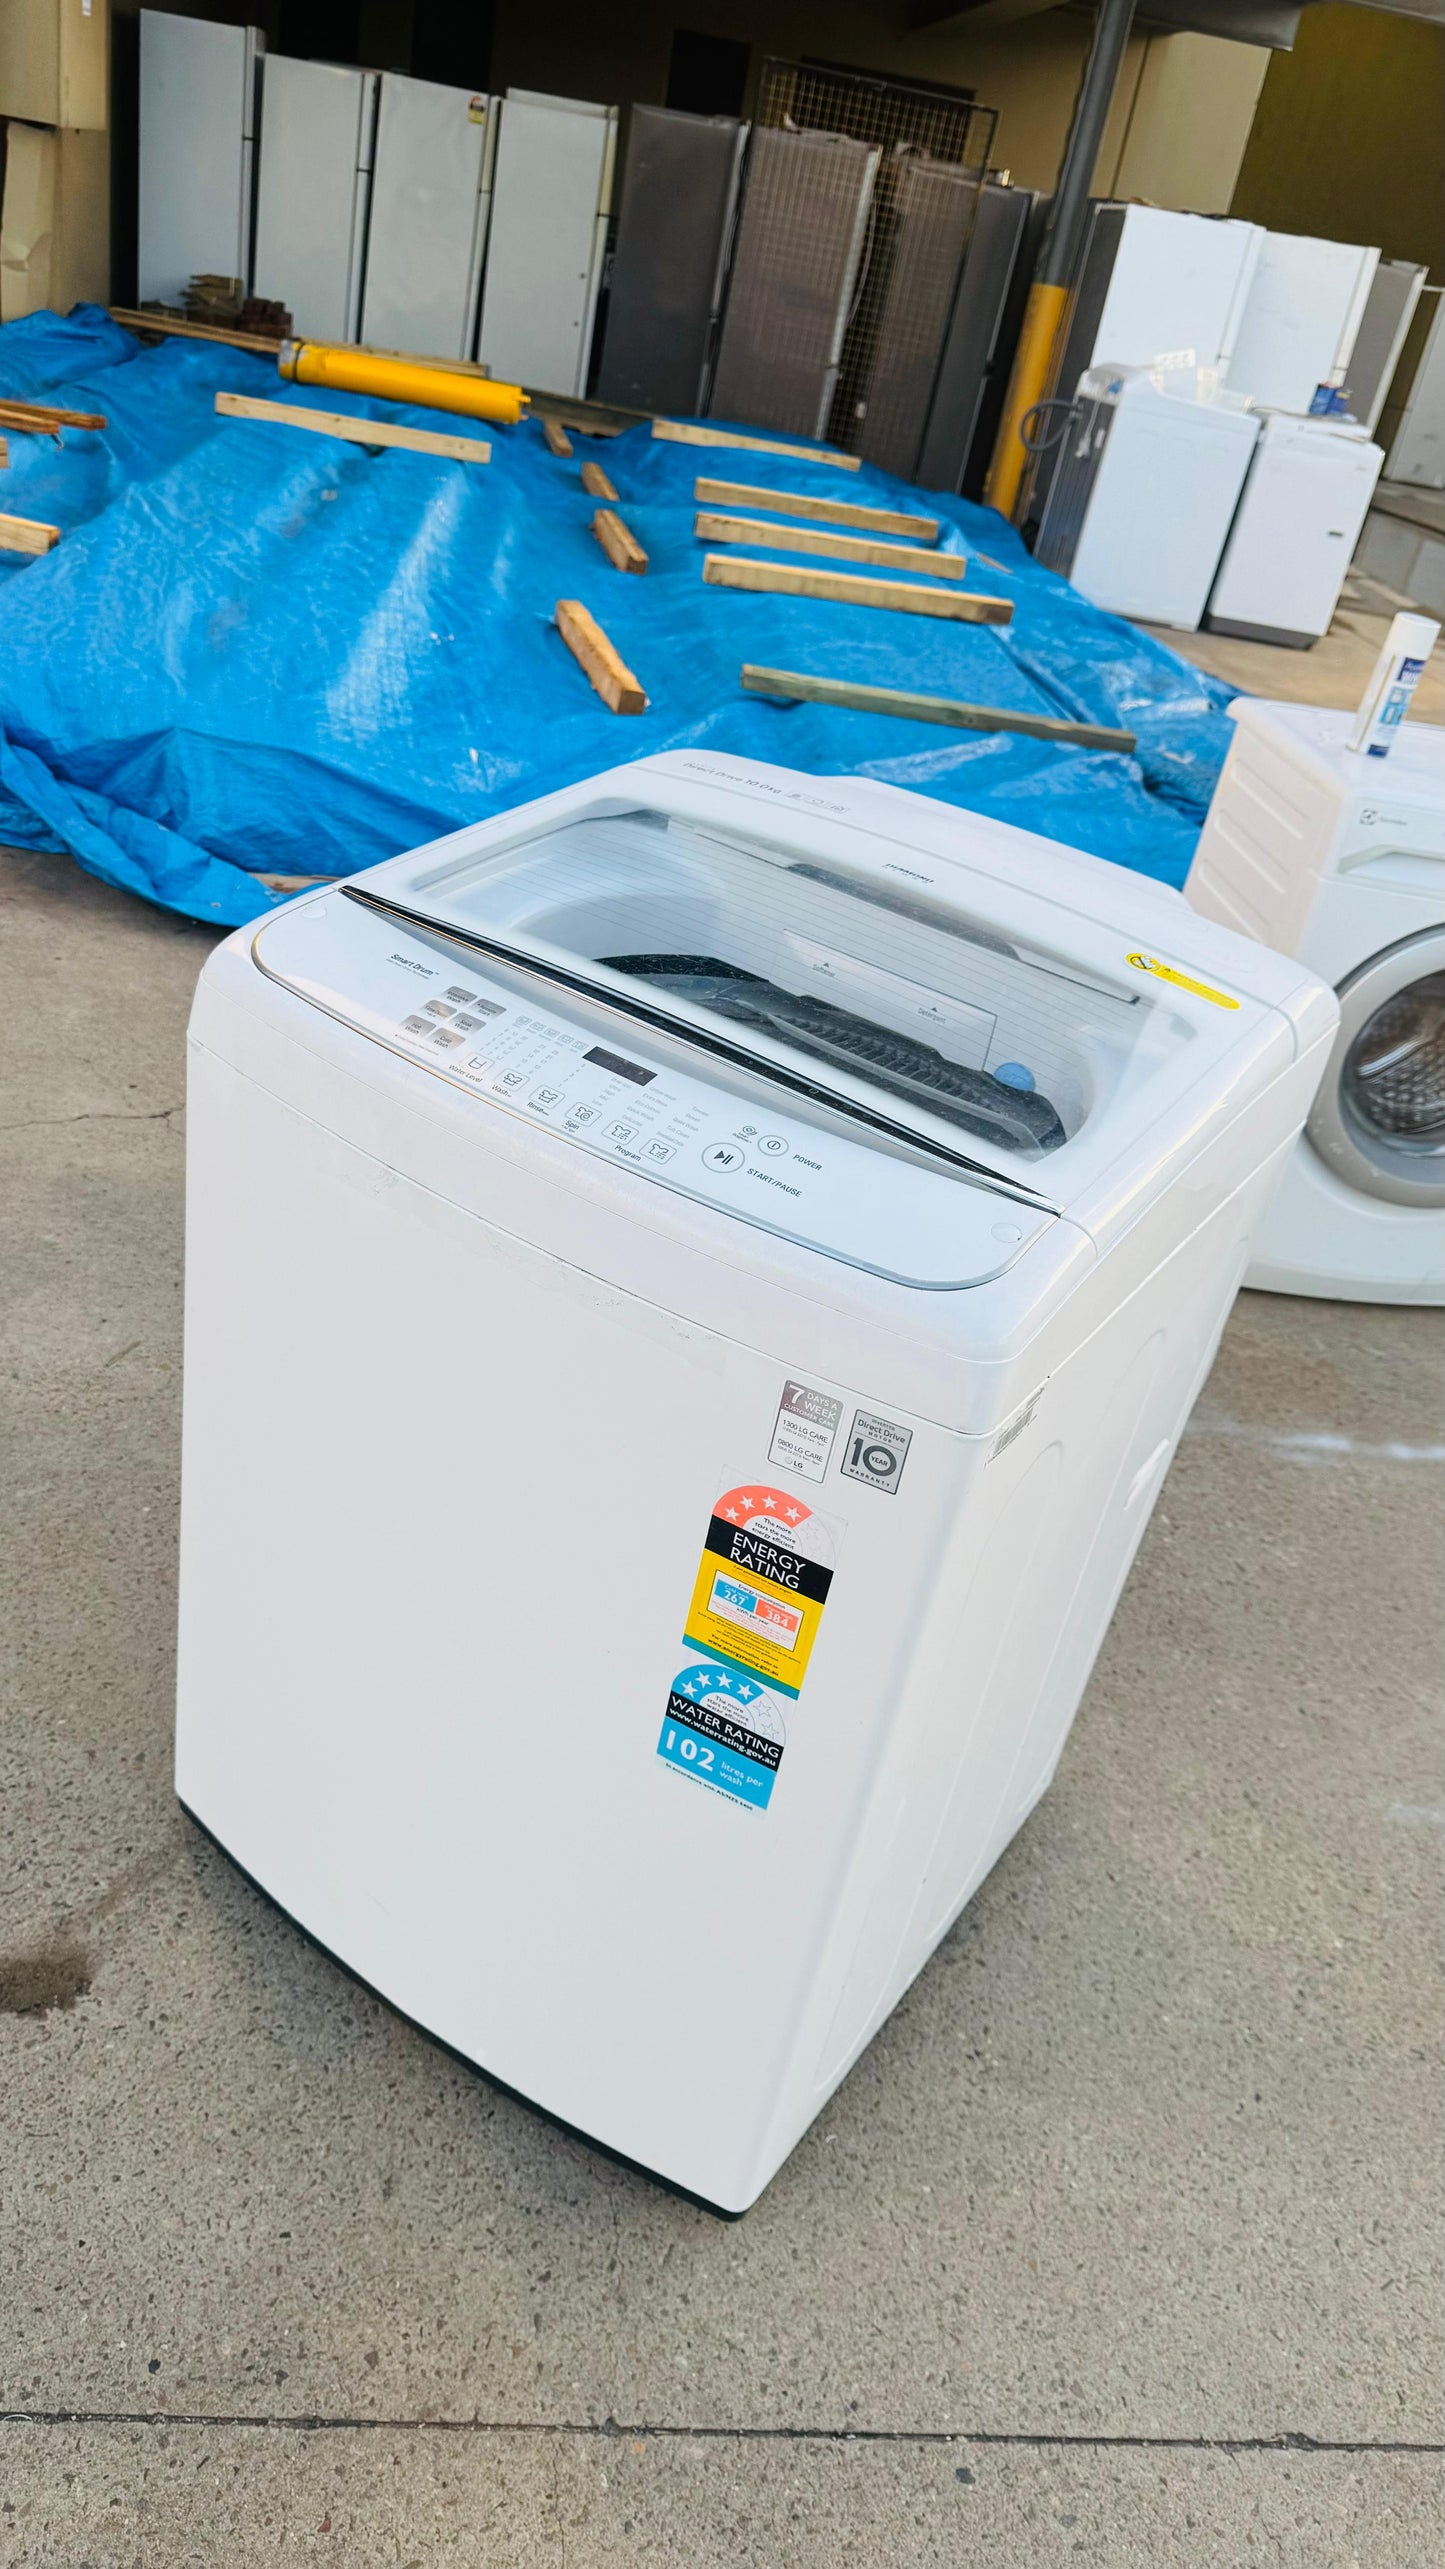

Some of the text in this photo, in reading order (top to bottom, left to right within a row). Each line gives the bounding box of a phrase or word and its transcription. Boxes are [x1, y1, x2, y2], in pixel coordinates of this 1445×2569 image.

[391, 954, 414, 968] Smart
[448, 1063, 483, 1083] Water Level
[492, 1084, 508, 1096] Wash
[565, 1120, 579, 1130] Spin
[614, 1145, 642, 1162] Program
[793, 1154, 822, 1171] POWER
[747, 1168, 802, 1198] START/PAUSE
[789, 1384, 838, 1411] 7 DAYS A
[784, 1402, 819, 1422] CUSTOMER
[804, 1401, 836, 1421] WEEK
[783, 1419, 798, 1431] 1300
[799, 1425, 809, 1435] LG
[809, 1430, 829, 1444] CARE
[857, 1419, 906, 1444] Direct Drive
[868, 1431, 892, 1444] MOTOR
[777, 1438, 794, 1449] 0800
[794, 1444, 804, 1454] LG
[804, 1450, 823, 1463] CARE
[851, 1437, 897, 1477] 10
[793, 1460, 804, 1470] LG
[871, 1456, 888, 1467] YEAR
[850, 1468, 890, 1487] WARRANTY
[755, 1522, 796, 1543] stars the more
[764, 1518, 792, 1534] The more
[752, 1527, 794, 1550] energy efficient
[733, 1532, 806, 1574] ENERGY
[730, 1547, 800, 1589] RATING
[724, 1590, 747, 1606] 267
[738, 1584, 754, 1596] Energy
[766, 1611, 789, 1628] 384
[706, 1703, 747, 1726] water efficient
[707, 1698, 749, 1722] stars the more
[716, 1696, 744, 1713] The more
[672, 1695, 779, 1759] WATER RATING
[669, 1708, 776, 1767] www.waterrating.gov.au
[666, 1729, 763, 1788] 102 litres per
[719, 1771, 743, 1787] wash
